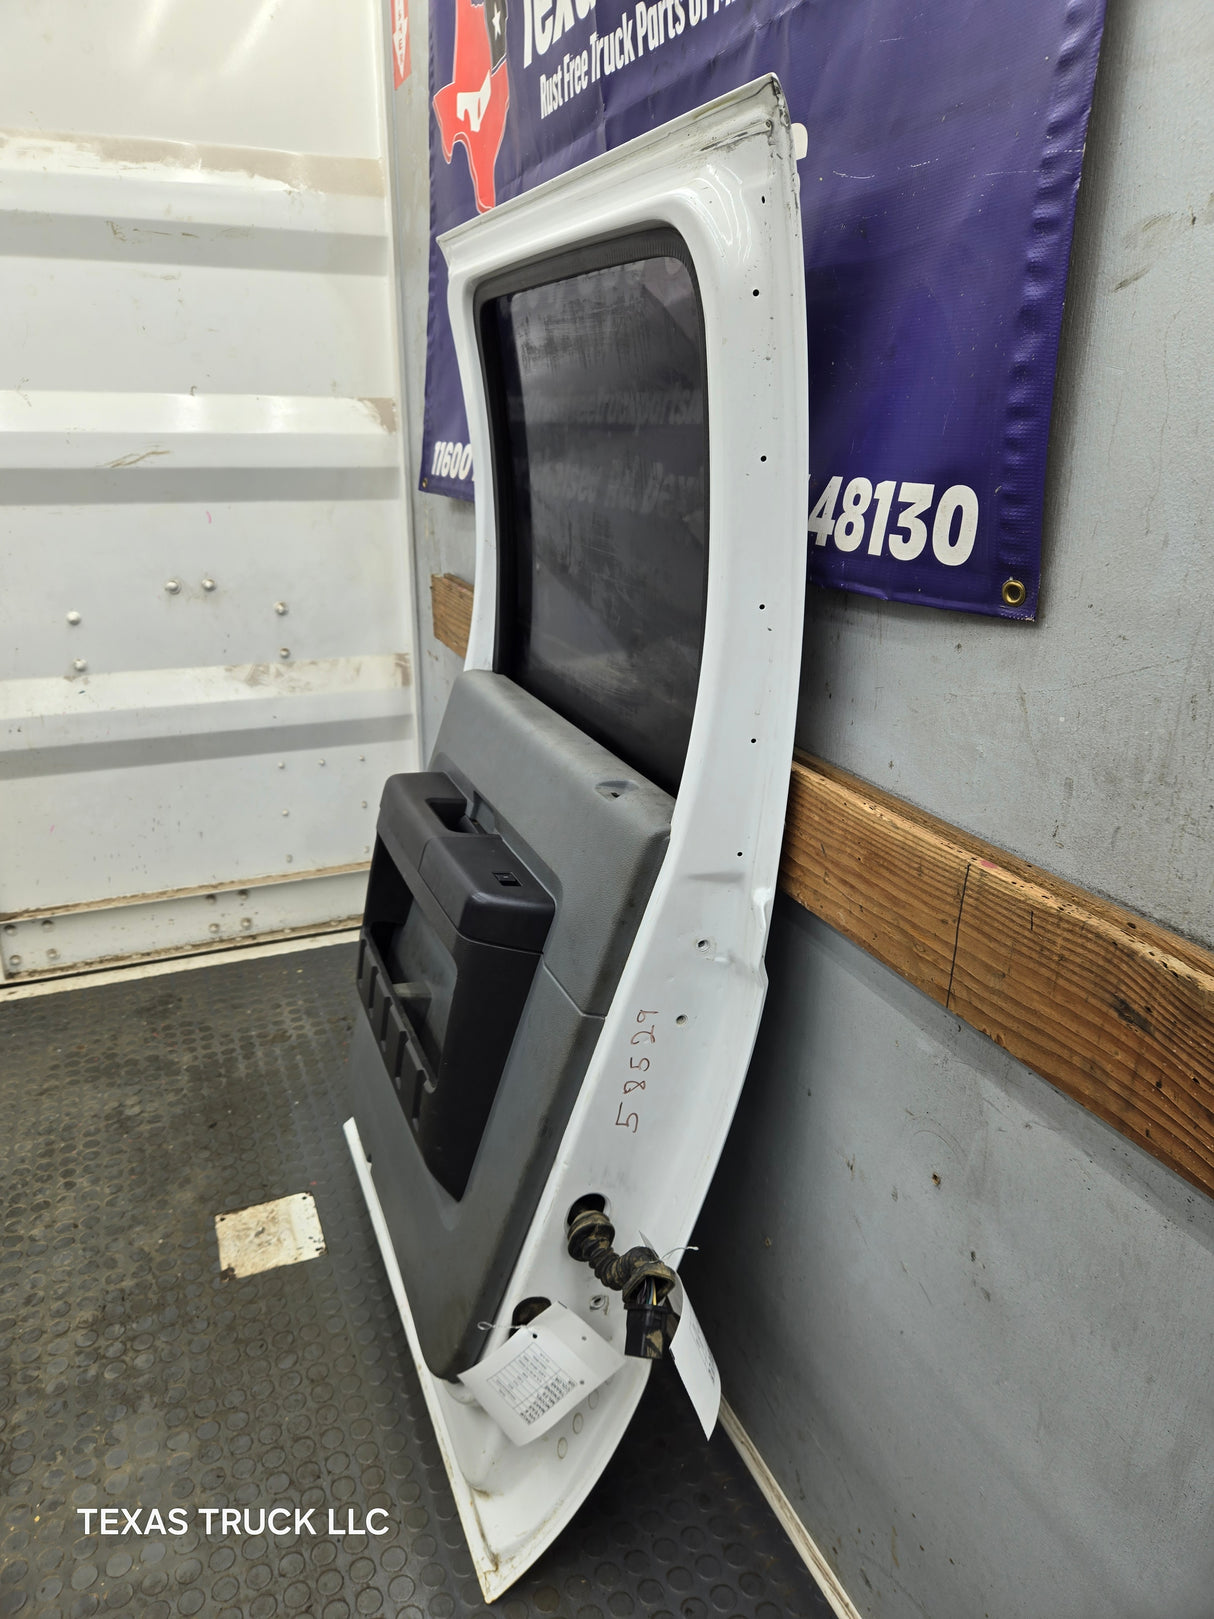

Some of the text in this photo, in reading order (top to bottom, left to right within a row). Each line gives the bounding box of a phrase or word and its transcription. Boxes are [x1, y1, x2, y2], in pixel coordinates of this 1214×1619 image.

[540, 64, 563, 120] Rust
[563, 49, 588, 103] Free
[589, 12, 635, 83] Truck
[635, 0, 686, 57] Parts
[431, 441, 473, 480] 11600
[808, 475, 979, 567] 48130
[615, 1009, 660, 1134] 58529
